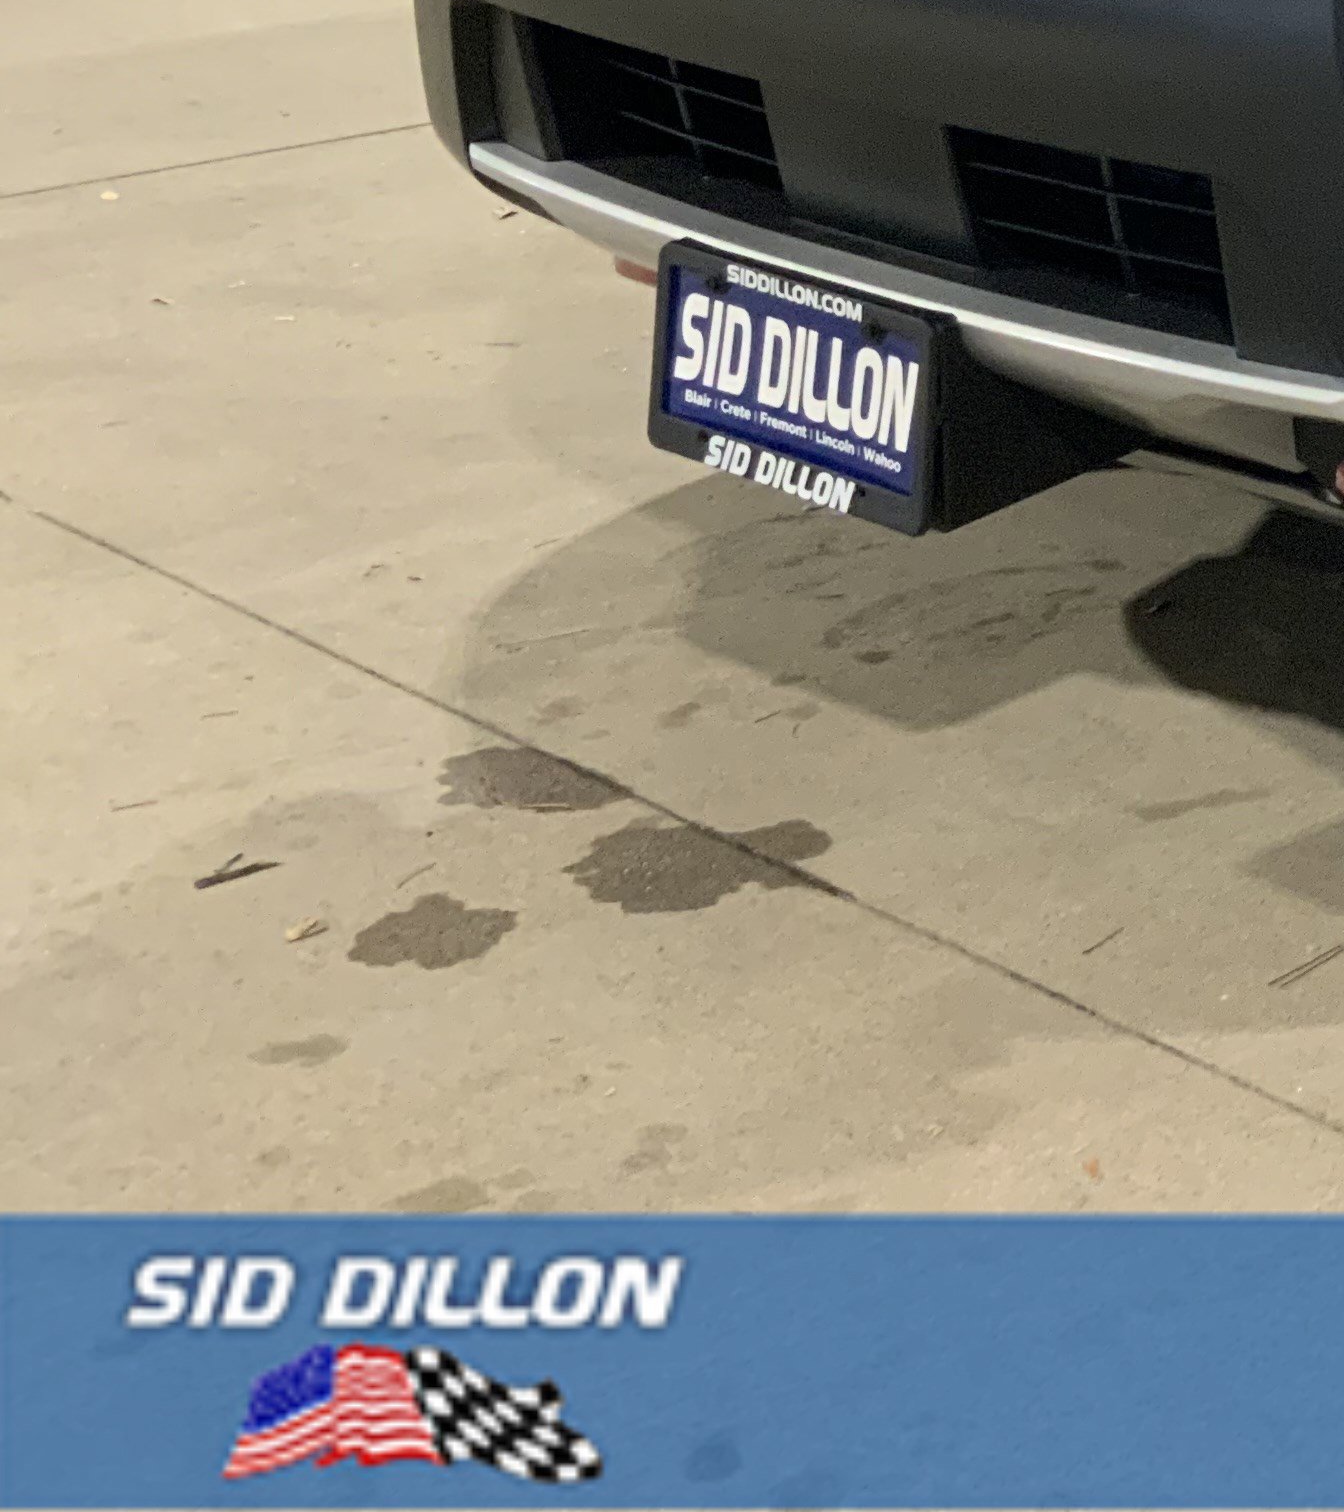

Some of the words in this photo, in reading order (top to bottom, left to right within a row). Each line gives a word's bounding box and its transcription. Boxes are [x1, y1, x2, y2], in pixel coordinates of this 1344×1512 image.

[726, 264, 863, 323] SIDDILLON.COM
[674, 292, 751, 396] SID
[757, 315, 919, 453] DILLON
[685, 389, 712, 409] Blair
[760, 411, 808, 438] Fremont
[815, 430, 855, 455] Lincoln
[864, 446, 901, 473] Wahoo
[704, 435, 751, 478] SID
[754, 450, 856, 514] DILLON
